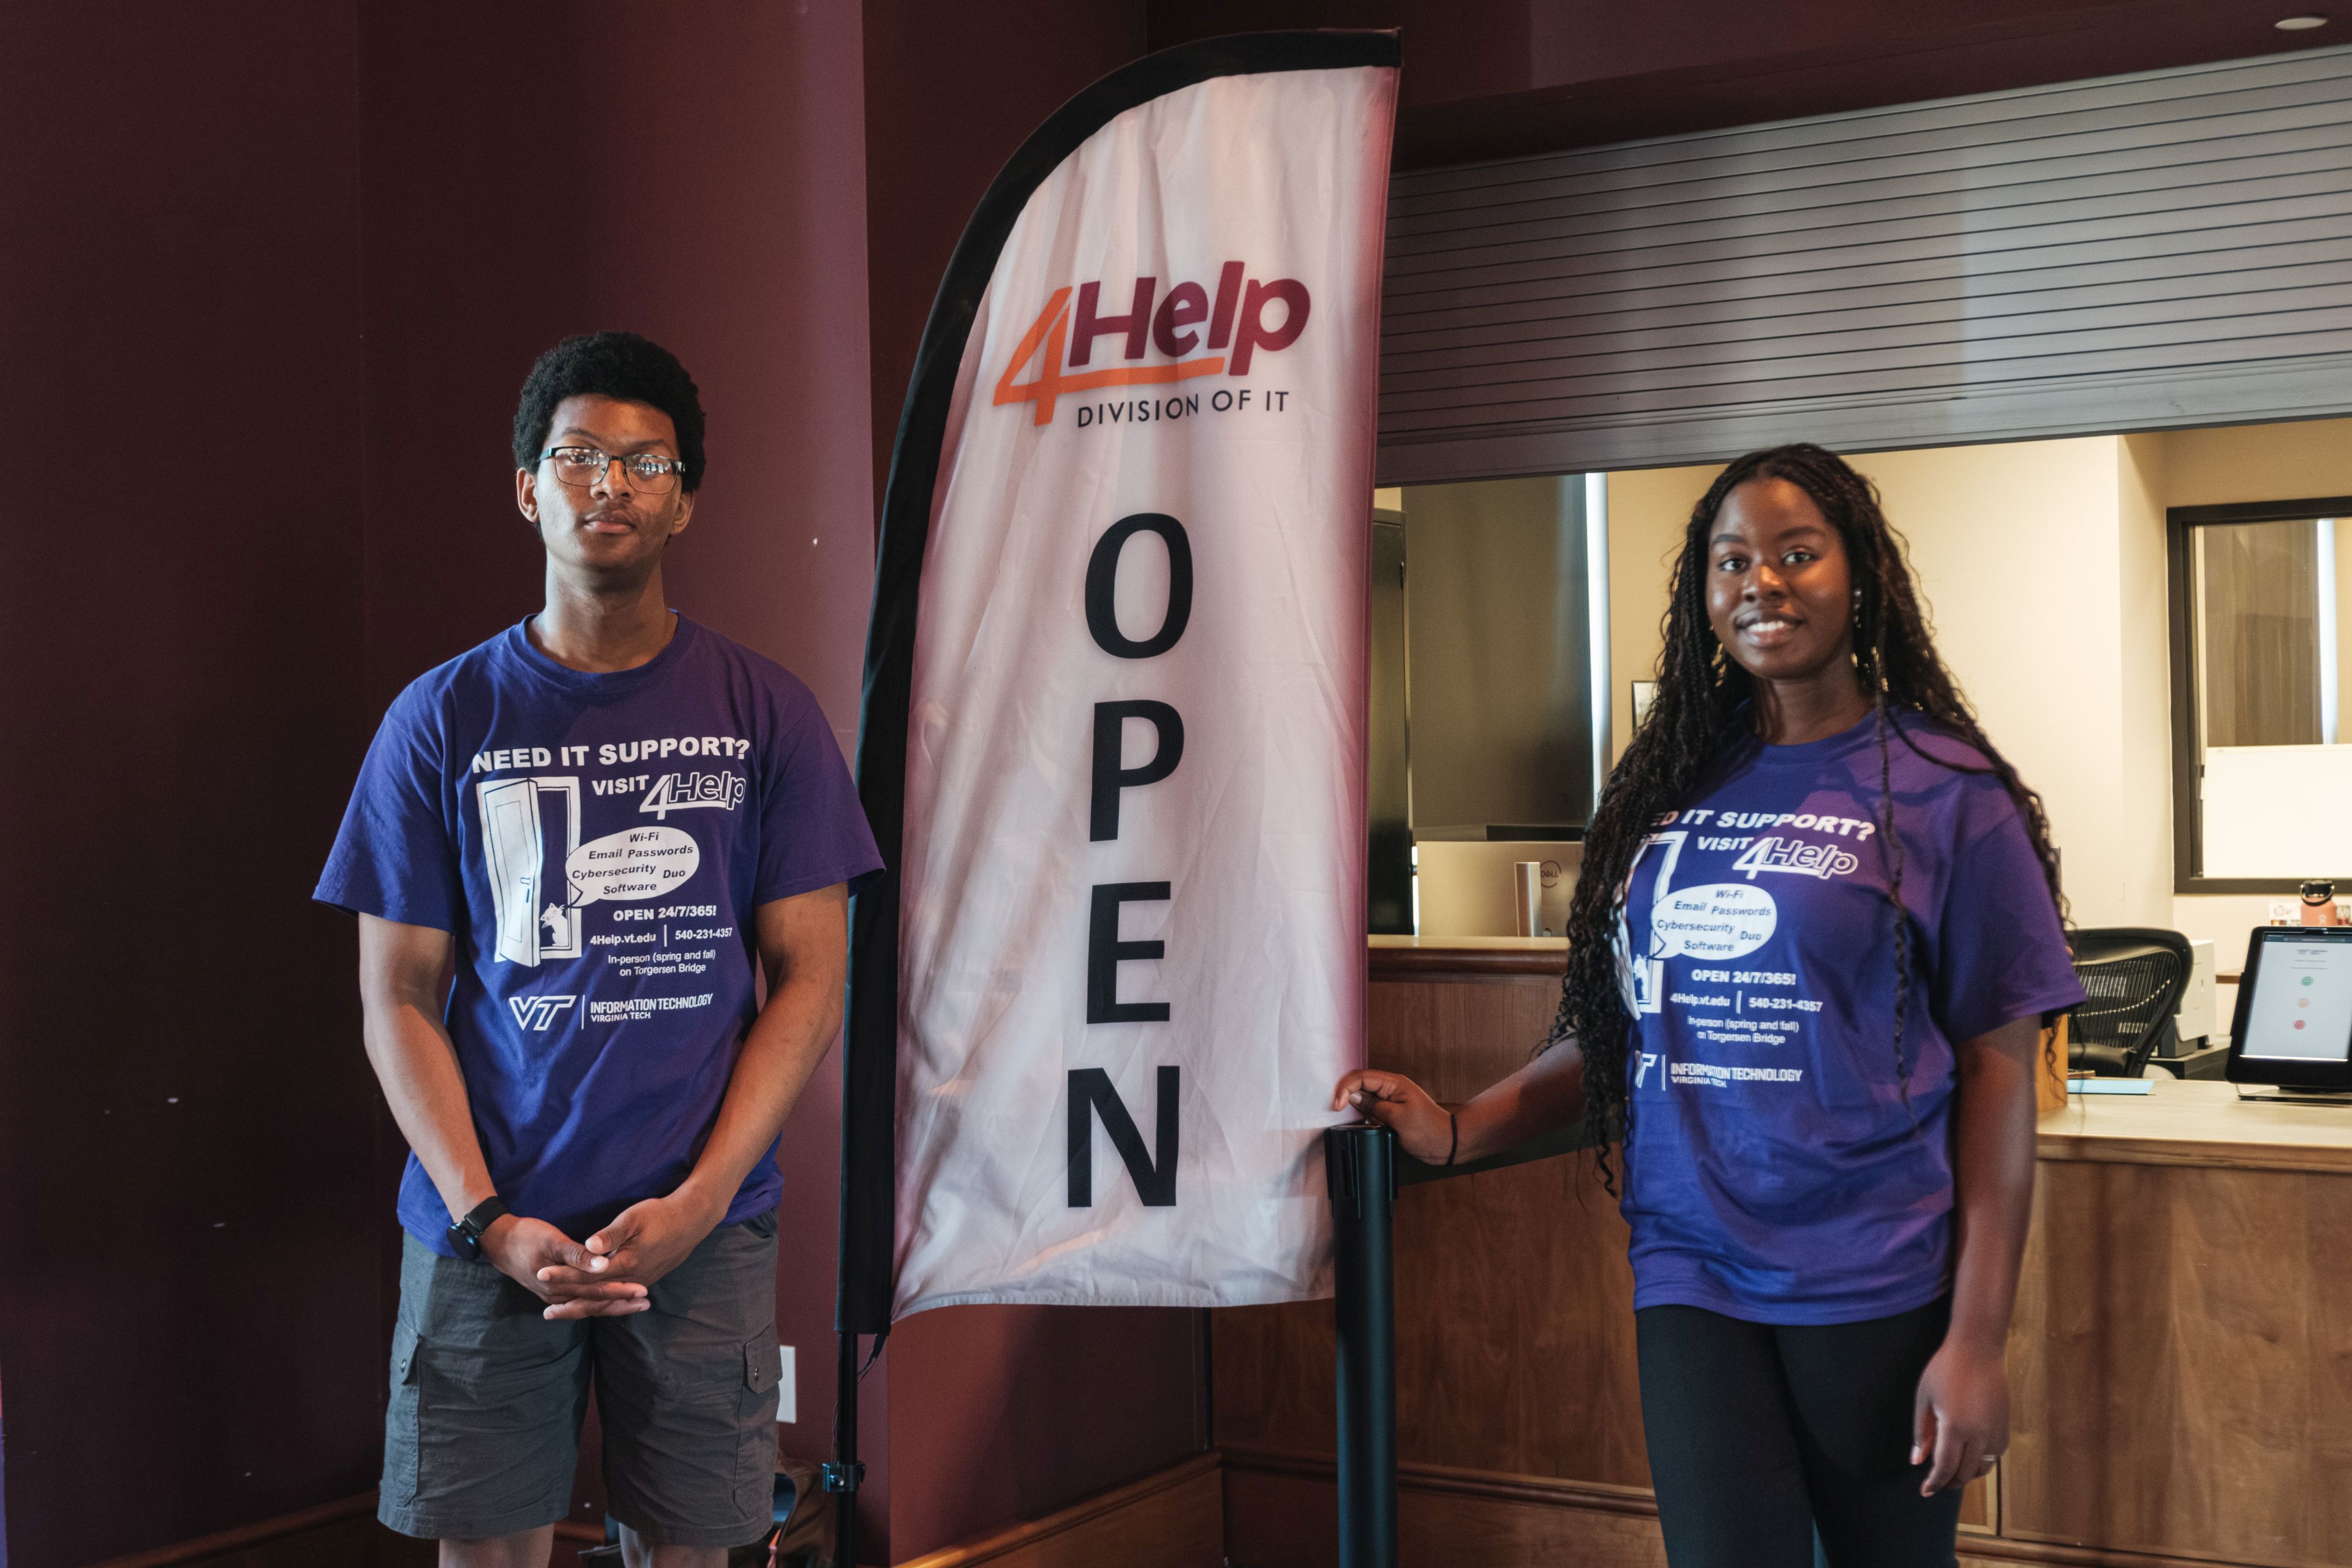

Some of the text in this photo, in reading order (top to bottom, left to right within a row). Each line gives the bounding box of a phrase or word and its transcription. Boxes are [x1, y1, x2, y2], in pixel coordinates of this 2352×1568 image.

[993, 261, 1311, 426] 4Help
[1078, 390, 1289, 428] DIVISION OF IT
[472, 736, 750, 774] NEED IT SUPPORT?
[592, 771, 746, 820] VISIT 4Help
[1681, 809, 1714, 825] IT
[1716, 811, 1875, 842] SUPPORT?
[630, 831, 659, 843] Wi-Fi
[589, 845, 693, 860] Email Passwords
[1068, 512, 1193, 1208] OPEN
[1697, 836, 1858, 880] VISIT 4Help
[571, 863, 685, 879] Cybersecurity Duo
[603, 881, 657, 895] Software
[1716, 889, 1744, 900] Wi-Fi
[613, 905, 717, 921] OPEN 24/7/365!
[1674, 901, 1771, 917] Email Passwords
[590, 927, 733, 946] 4Help.vt.edu 540-231-4357
[1657, 919, 1762, 941] Cybersecurity Duo
[1684, 940, 1734, 952] Software
[608, 949, 716, 966] In-person (spring and fall)
[634, 965, 676, 977] Torgersen
[678, 963, 706, 974] Bridge
[1691, 969, 1796, 985] OPEN 24/7/365!
[590, 993, 713, 1014] INFORMATION TECHNOLOGY
[1670, 993, 1823, 1012] 4Help.vt.edu 540-231-4357
[509, 995, 576, 1031] VT
[591, 1014, 628, 1022] VIRGINIA
[1687, 1016, 1800, 1033] In-person (spring and fall)
[1707, 1030, 1751, 1043] Torgersen
[1752, 1033, 1786, 1046] Bridge
[1670, 1063, 1803, 1082] INFORMATION TECHNOLOGY
[1671, 1076, 1711, 1085] VIRGINIA
